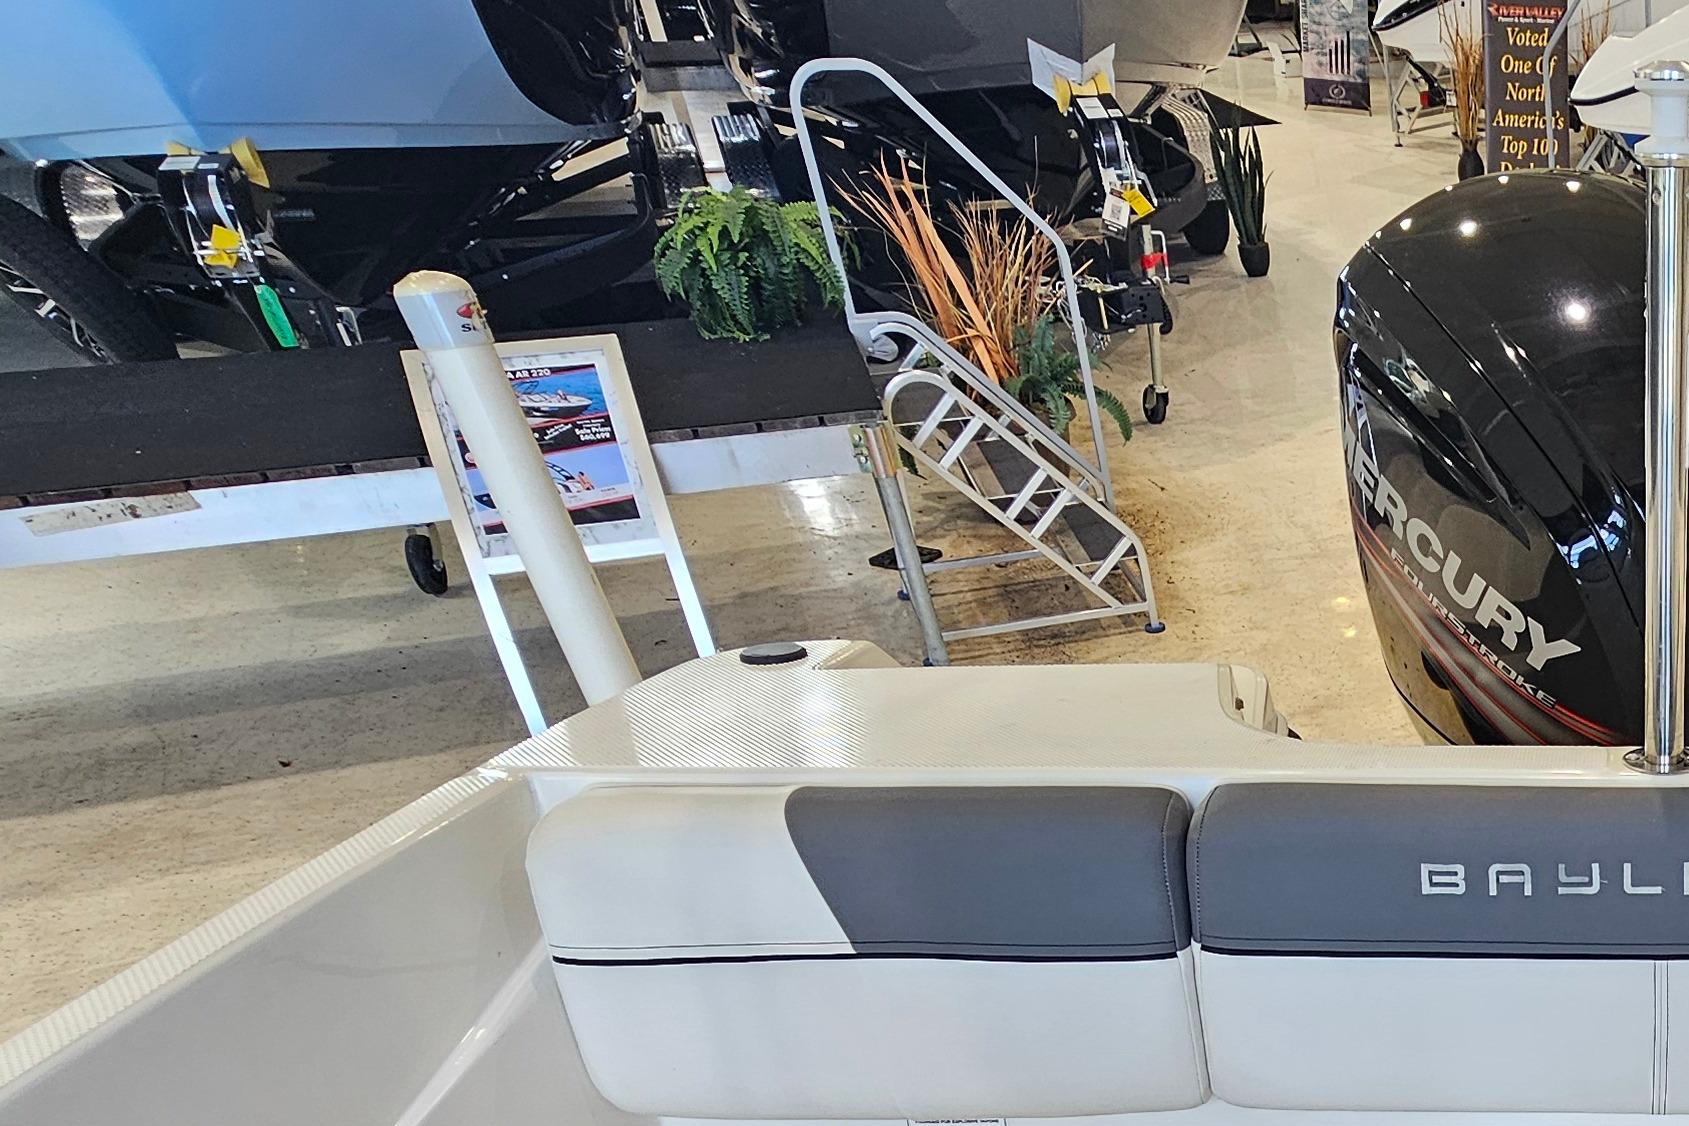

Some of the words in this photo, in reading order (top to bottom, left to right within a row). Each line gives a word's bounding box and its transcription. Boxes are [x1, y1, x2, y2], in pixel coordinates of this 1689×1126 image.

[1487, 3, 1524, 17] RIVER
[1525, 4, 1565, 18] VALLEY
[1506, 27, 1549, 47] Voted
[1500, 54, 1532, 75] One
[1492, 109, 1565, 130] Americ's
[1500, 135, 1528, 160] Top
[530, 368, 551, 378] 220
[1390, 547, 1557, 707] FOURSTROKE
